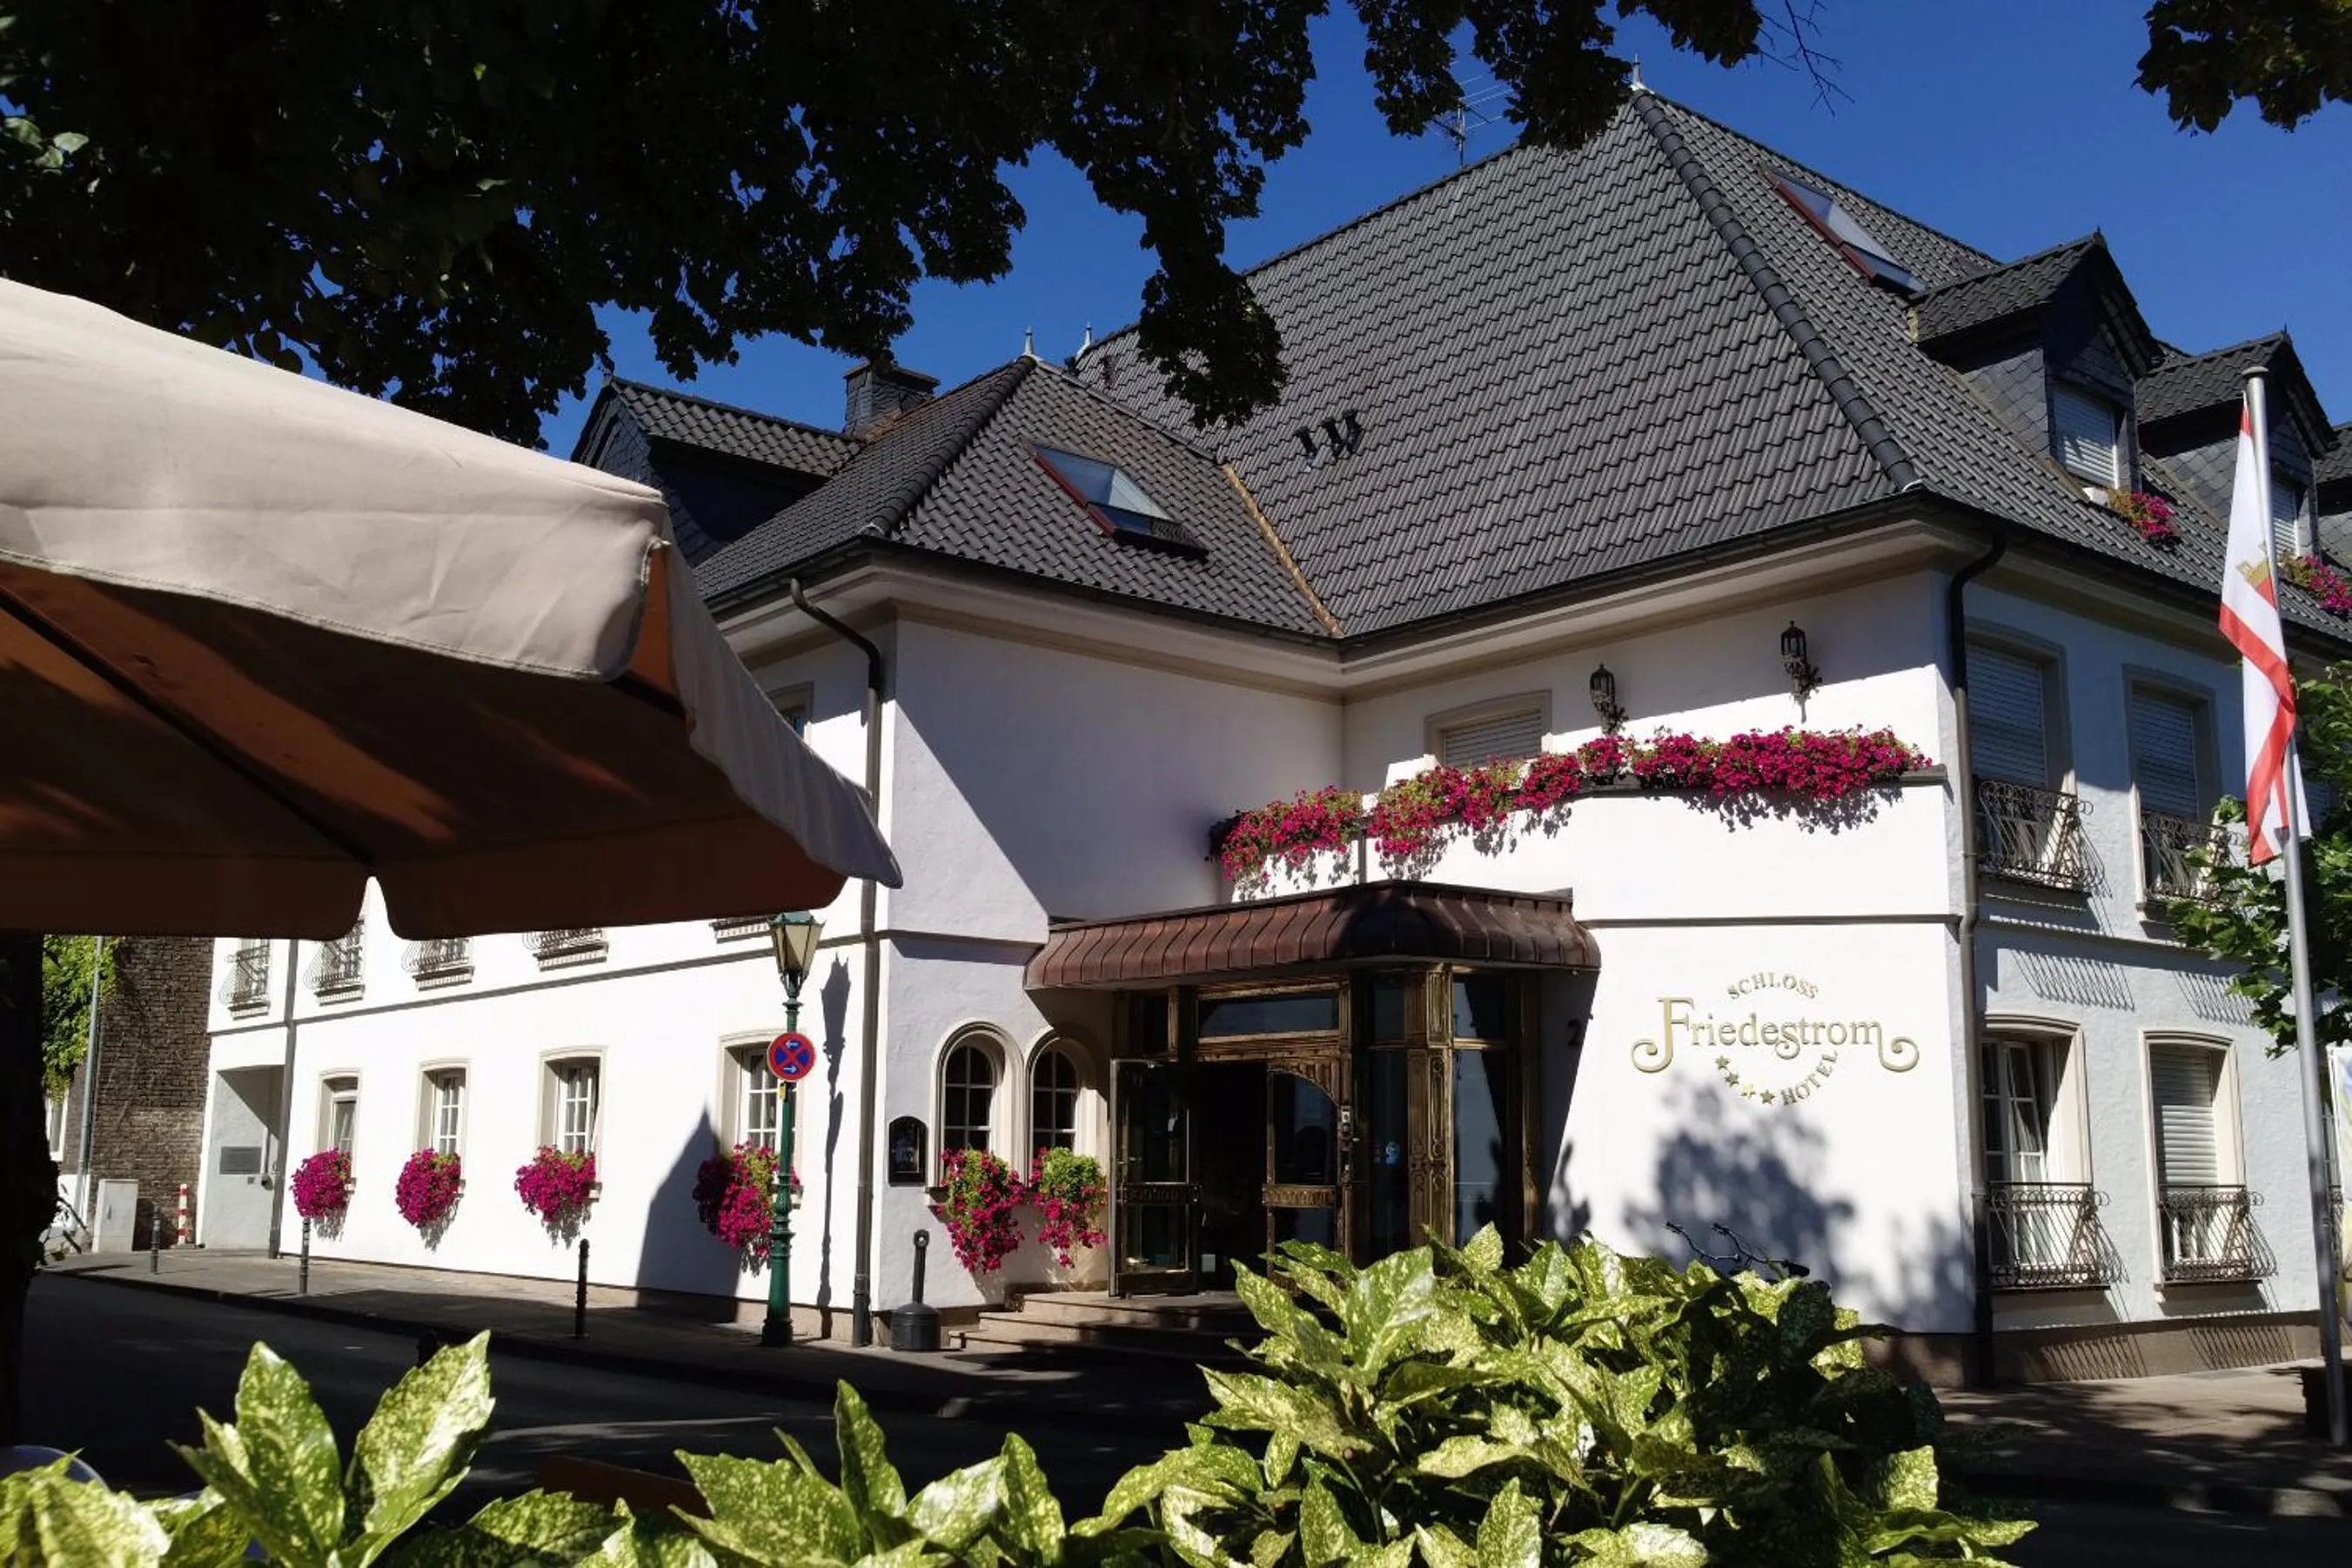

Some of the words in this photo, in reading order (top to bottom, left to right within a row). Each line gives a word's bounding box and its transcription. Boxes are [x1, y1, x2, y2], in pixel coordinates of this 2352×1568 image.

[1727, 971, 1819, 1000] SCHLOSS
[1567, 1019, 1582, 1046] 2
[1631, 997, 1920, 1074] Friedestrom
[1780, 1049, 1839, 1106] HOTEL
